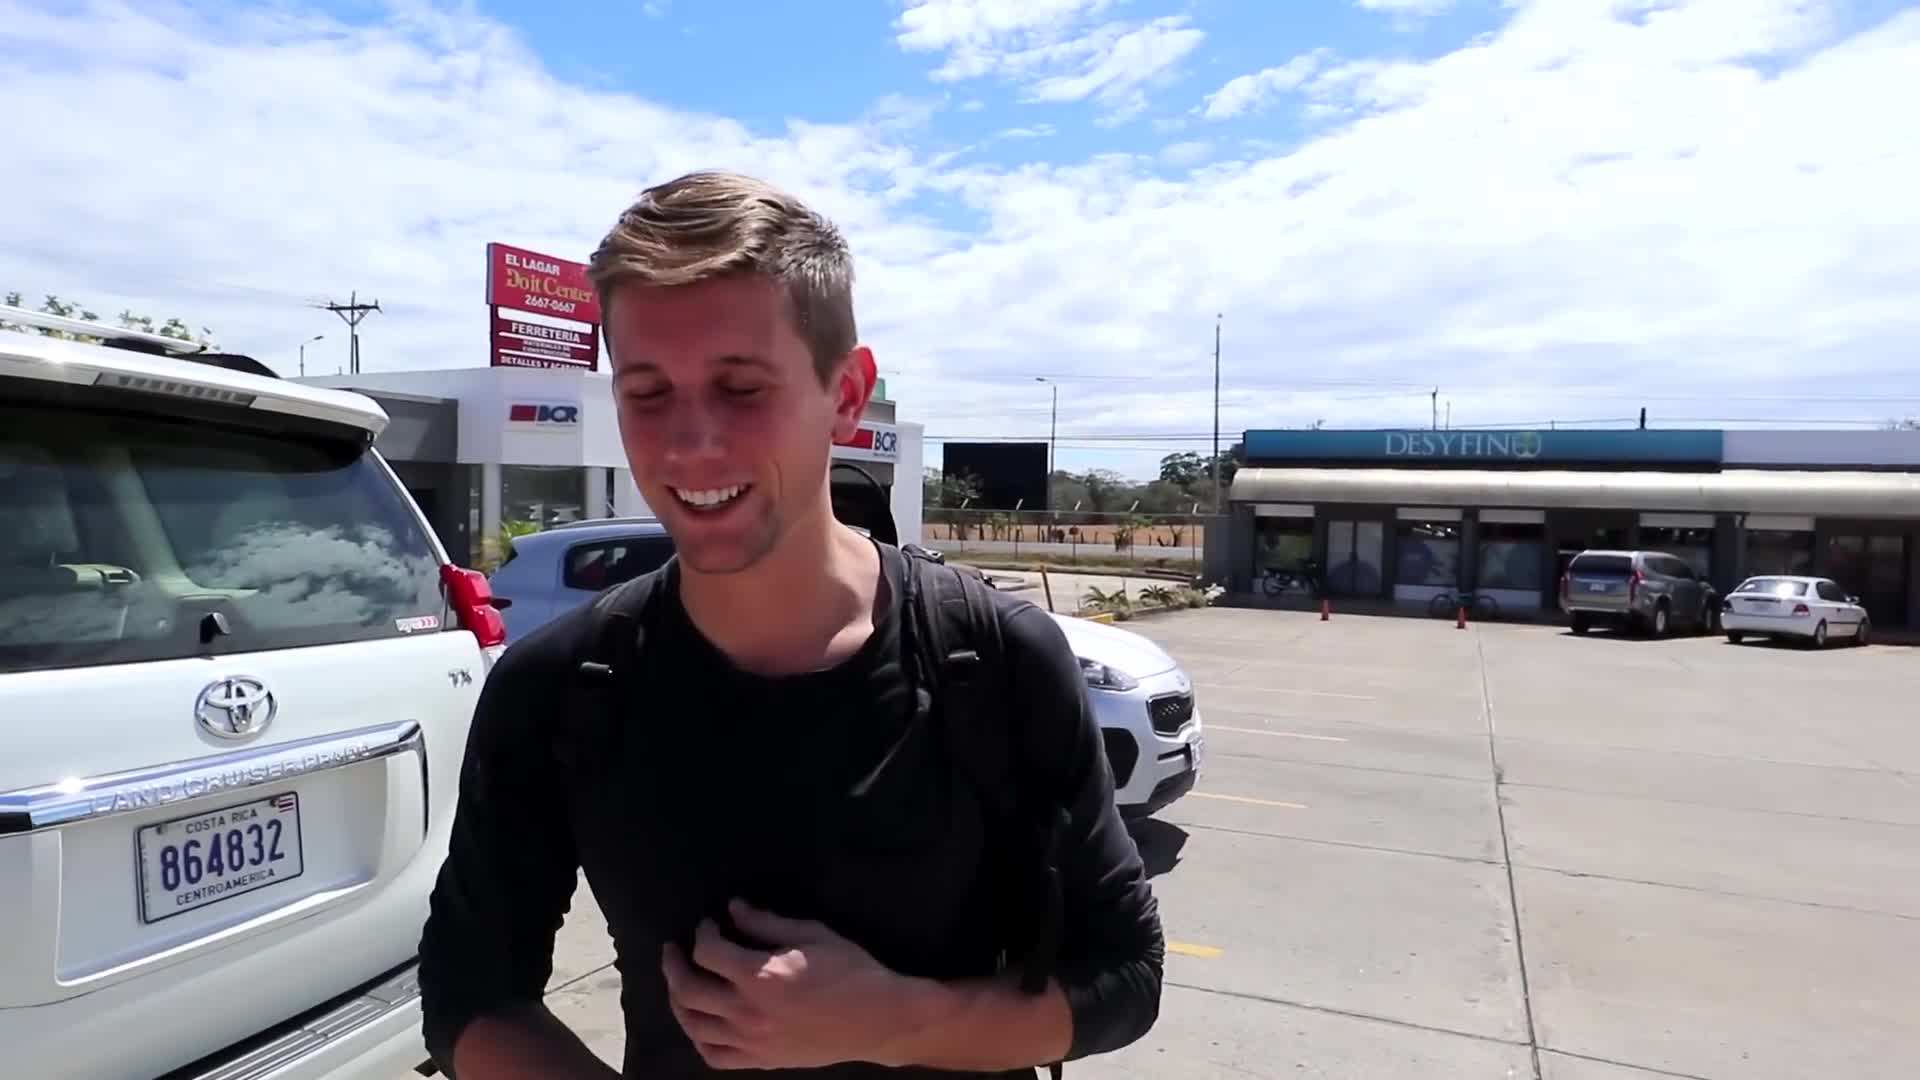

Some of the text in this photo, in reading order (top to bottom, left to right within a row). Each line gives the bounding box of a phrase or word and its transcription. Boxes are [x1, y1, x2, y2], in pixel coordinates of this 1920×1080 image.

[505, 253, 560, 276] EL LAGAR
[544, 277, 592, 302] Center
[524, 294, 576, 313] 2667-0667
[500, 356, 541, 368] DETALLES
[874, 430, 897, 452] BCR
[182, 759, 304, 797] CRUISER
[185, 808, 258, 834] COSTA RICA
[160, 818, 285, 892] 864832
[175, 867, 276, 906] CENTROAMERICA
